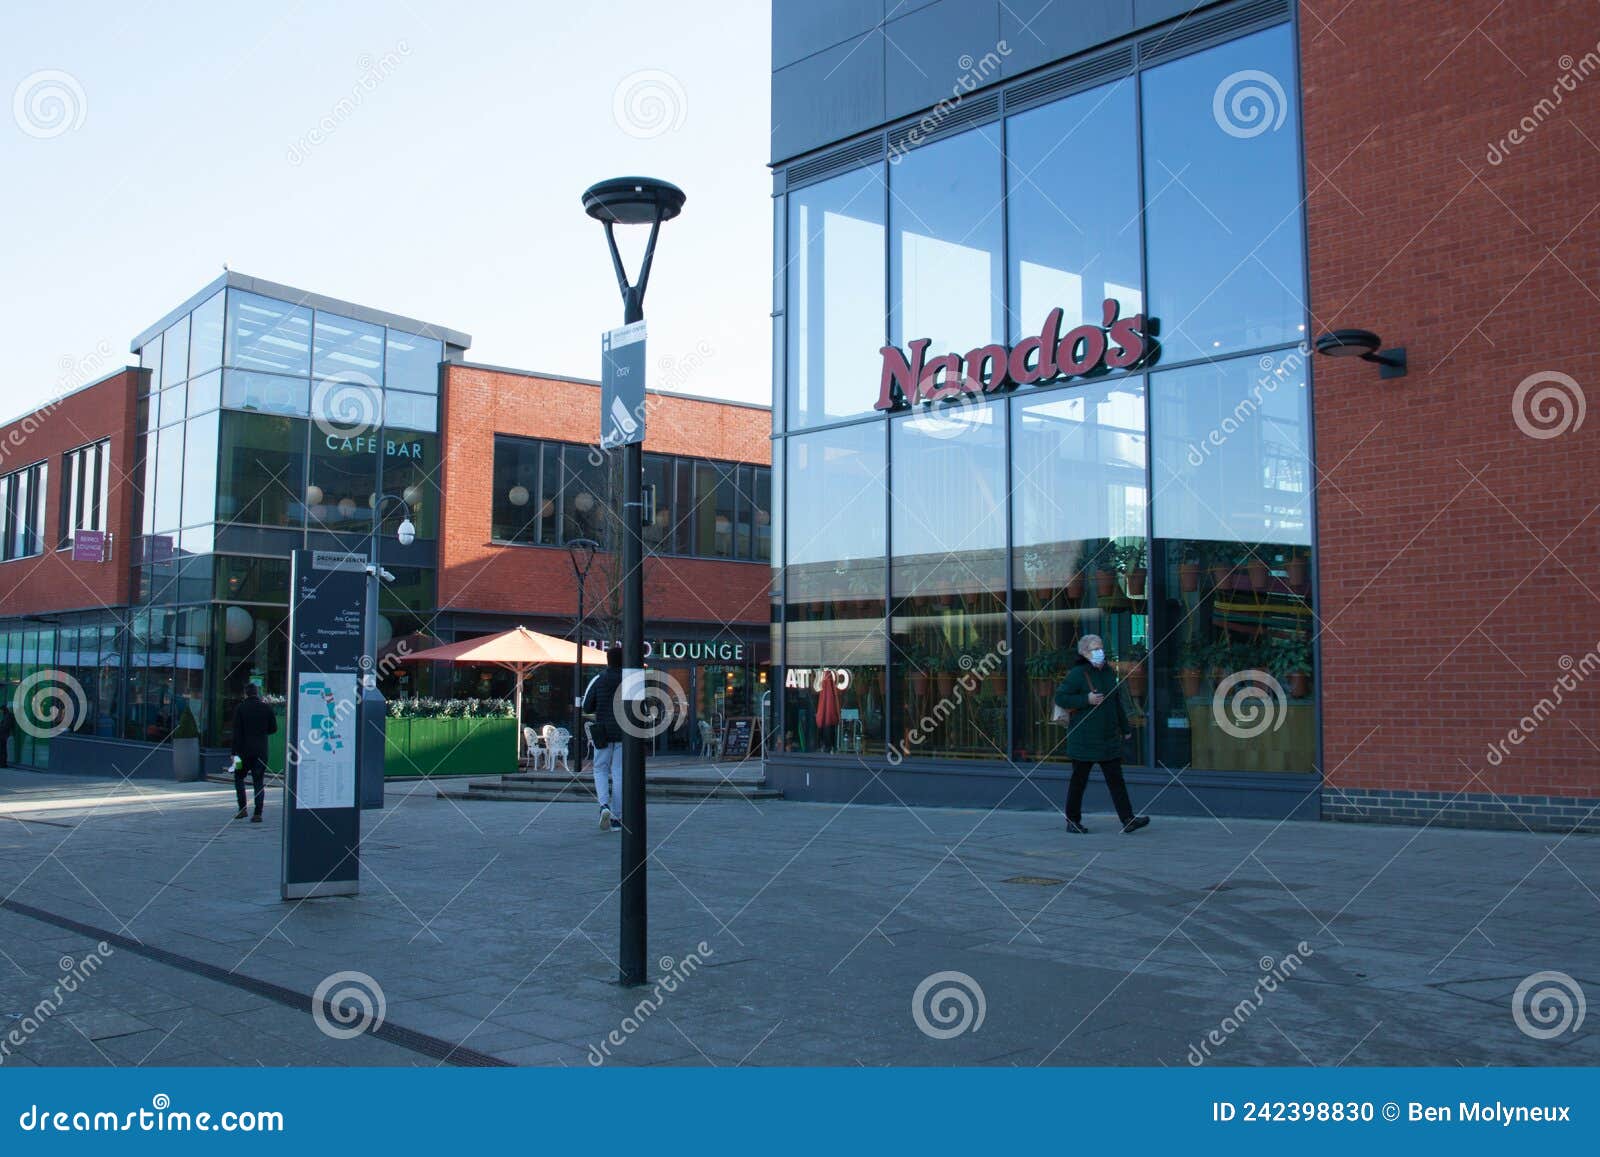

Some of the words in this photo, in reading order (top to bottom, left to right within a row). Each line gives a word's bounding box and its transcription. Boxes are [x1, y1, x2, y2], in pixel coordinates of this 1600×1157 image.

[874, 298, 1150, 411] Nando's
[326, 433, 377, 454] CAFÉ
[386, 441, 422, 458] BAR
[662, 641, 743, 660] LOUNGE
